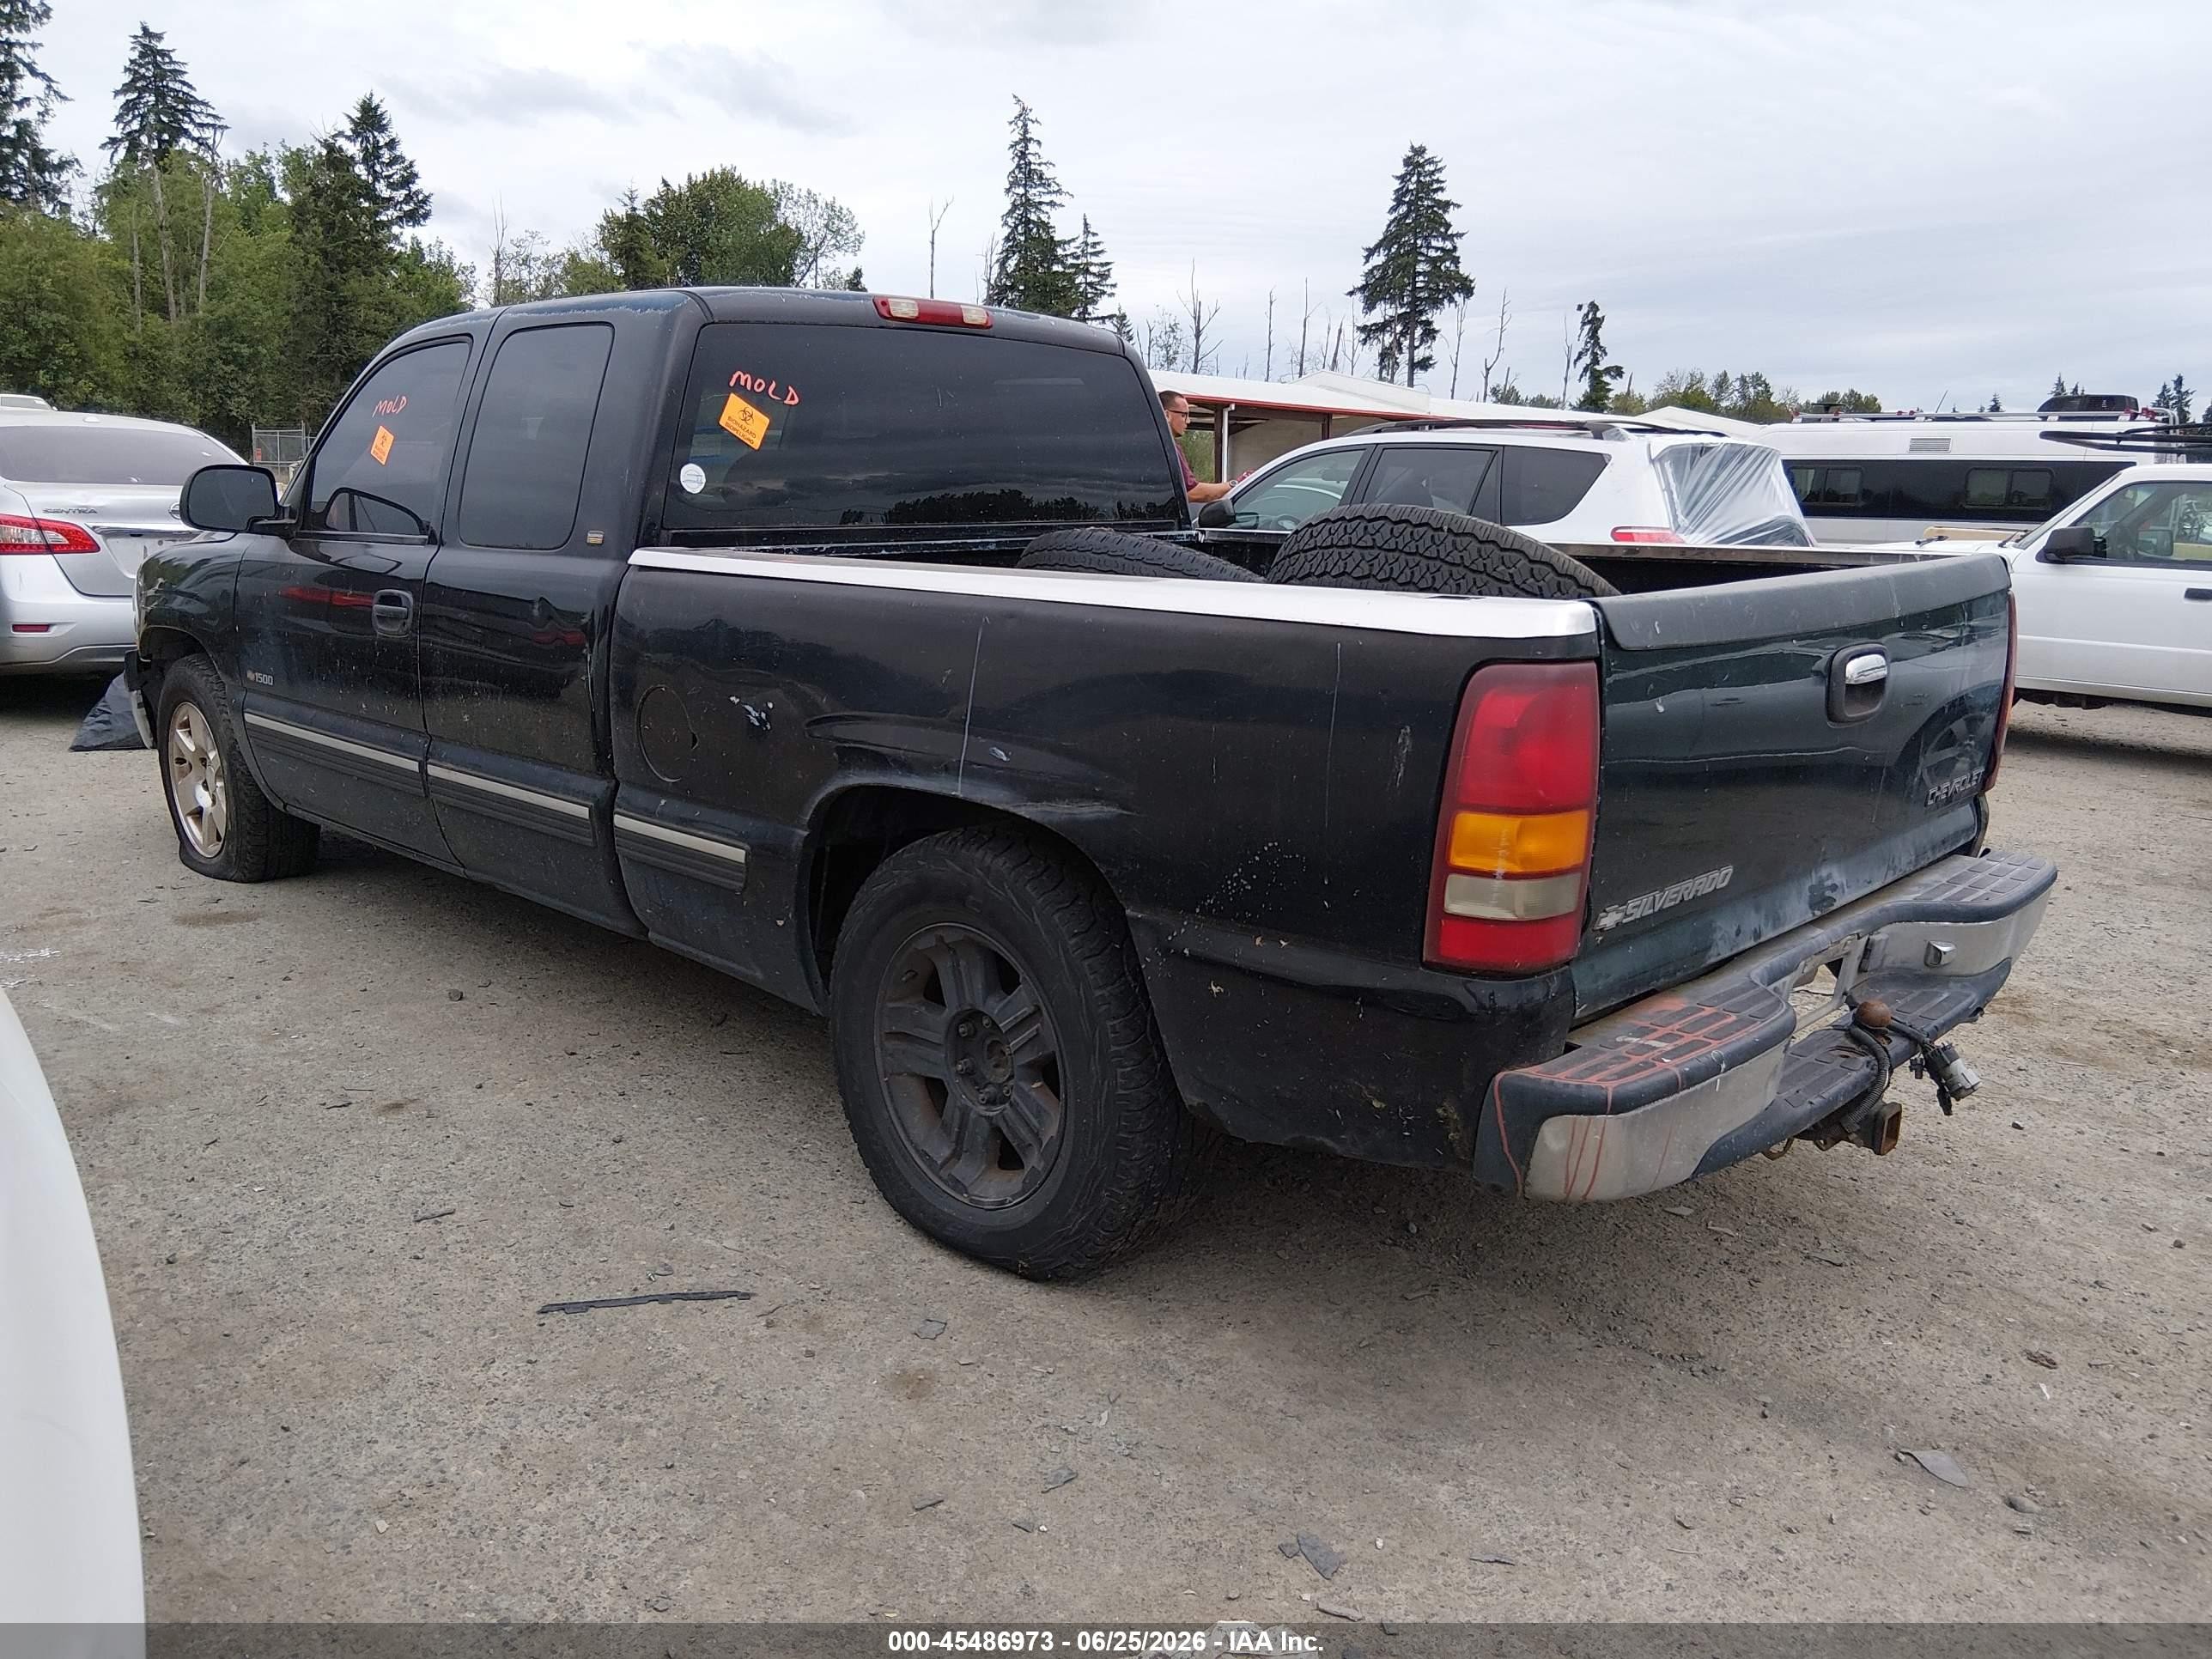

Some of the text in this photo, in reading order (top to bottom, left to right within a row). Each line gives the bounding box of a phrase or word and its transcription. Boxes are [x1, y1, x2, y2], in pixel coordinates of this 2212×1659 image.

[729, 370, 799, 405] MOLD
[724, 422, 755, 445] BIOPELIGRO
[726, 416, 757, 439] BIOHAZARD
[255, 672, 274, 686] 1500
[1927, 769, 1985, 805] CHEVROLET
[1622, 865, 1734, 923] SILVERADO
